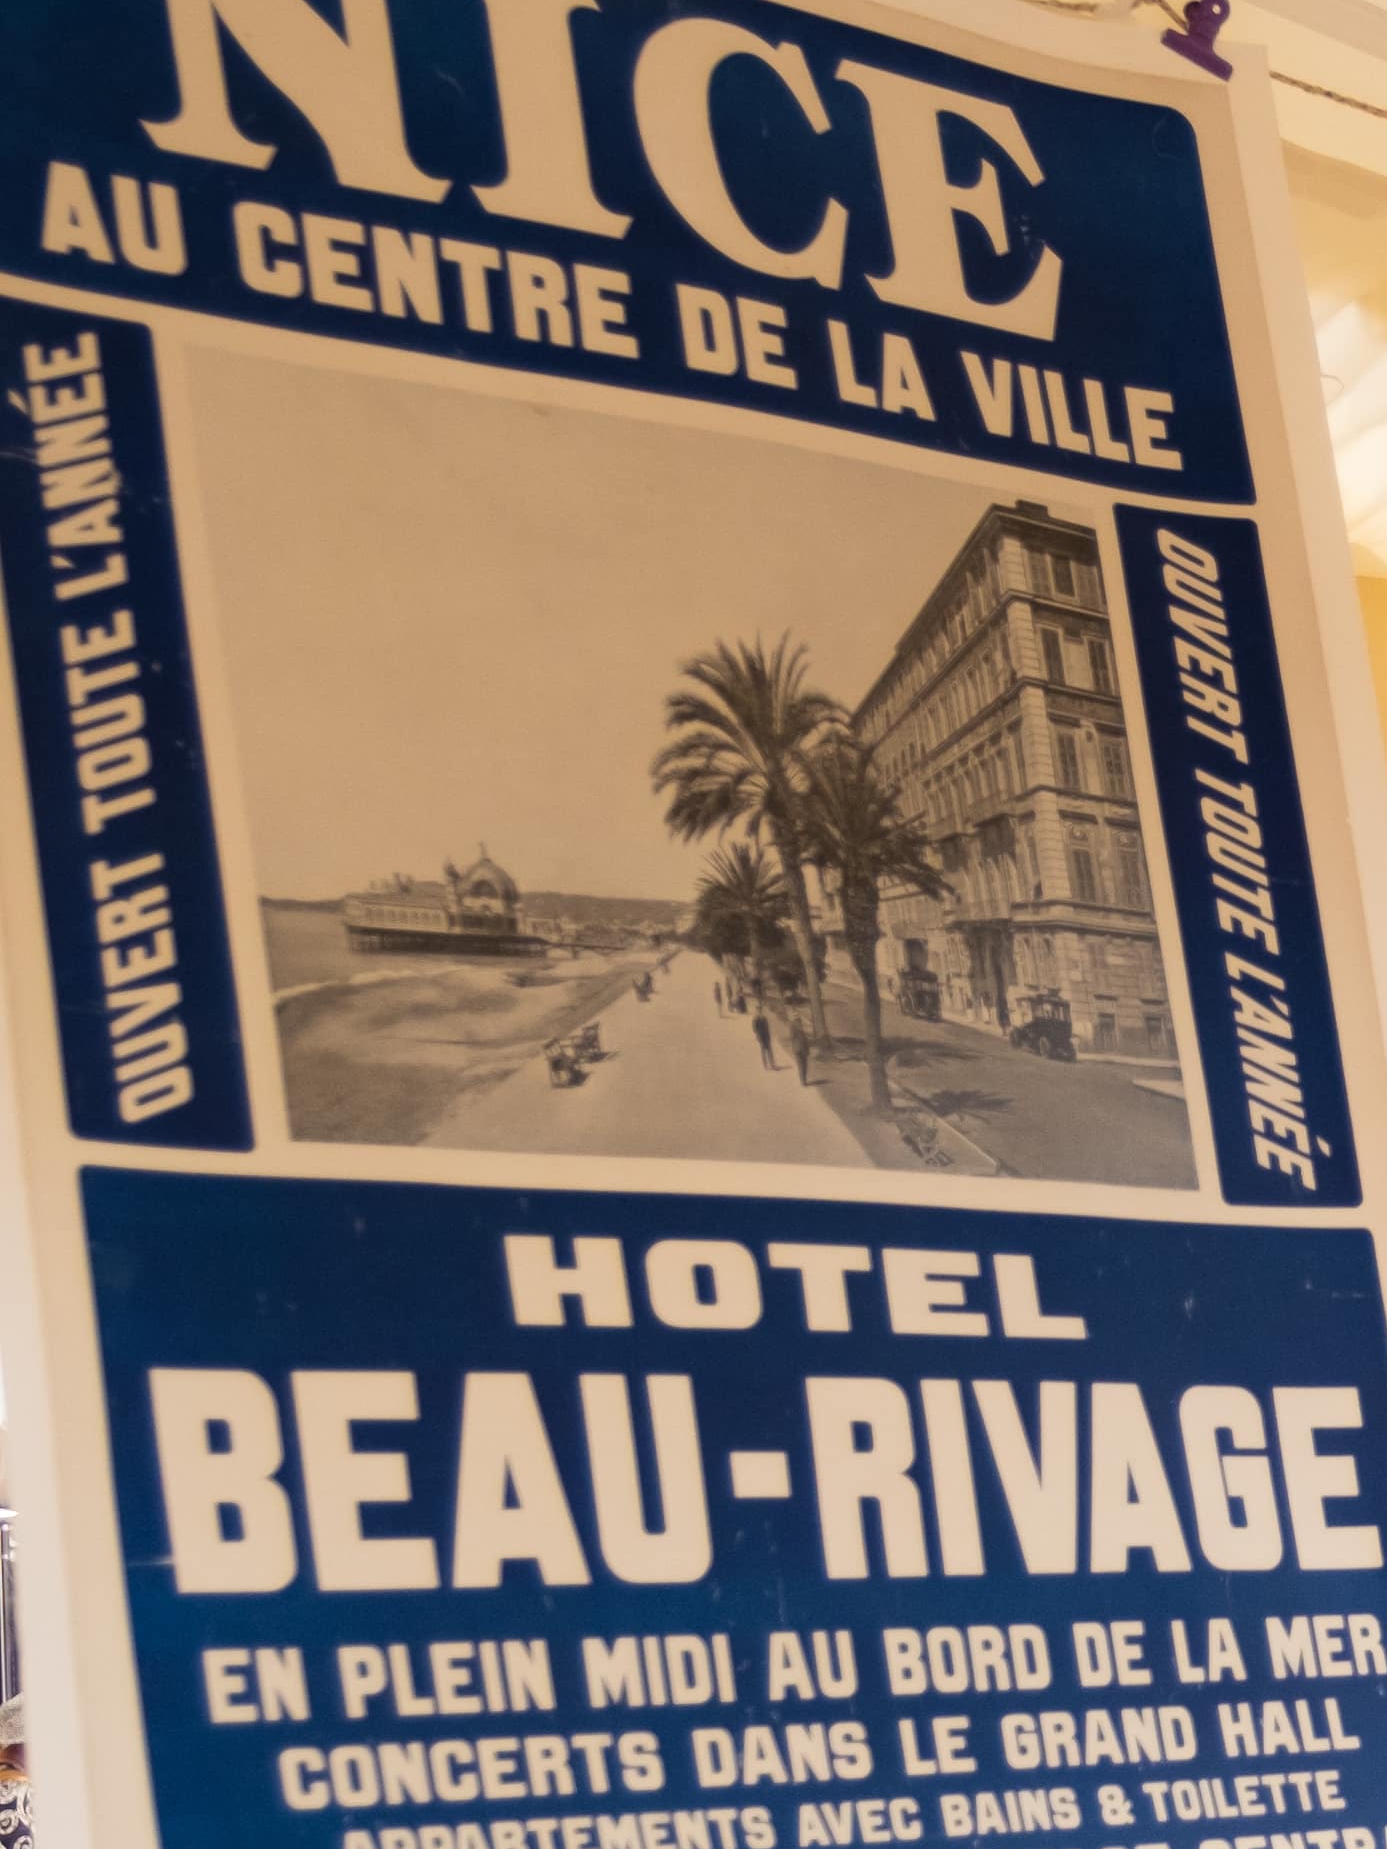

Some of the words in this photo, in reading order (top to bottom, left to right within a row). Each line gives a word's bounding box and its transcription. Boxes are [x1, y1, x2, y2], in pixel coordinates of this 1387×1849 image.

[43, 162, 186, 275] AU
[233, 201, 638, 358] CENTRE
[676, 284, 797, 389] DE
[828, 320, 935, 421] LA
[961, 351, 1182, 470] VILLE
[61, 610, 154, 834] TOUTE
[1157, 529, 1248, 763] OUVERT
[1195, 769, 1279, 955] TOUTE
[90, 854, 192, 1123] OUVERT
[503, 1234, 1088, 1340] HOTEL
[148, 1367, 1384, 1594] BEAU-RIVAGE
[202, 1647, 306, 1725] EN
[337, 1639, 556, 1719] PLEIN
[582, 1633, 736, 1709] MIDI
[768, 1629, 858, 1702] AU
[882, 1623, 1052, 1696] BORD
[1072, 1620, 1153, 1688] DE
[1171, 1617, 1249, 1686] LA
[278, 1731, 665, 1811] CONCERTS
[691, 1721, 873, 1789] DANS
[898, 1715, 977, 1777] LE
[1000, 1705, 1198, 1771] GRAND
[1217, 1697, 1361, 1759] HALL
[798, 1797, 923, 1848] AVEC
[939, 1787, 1082, 1838] BAINS
[1096, 1784, 1136, 1827] &
[1141, 1769, 1347, 1823] TOILETTE
